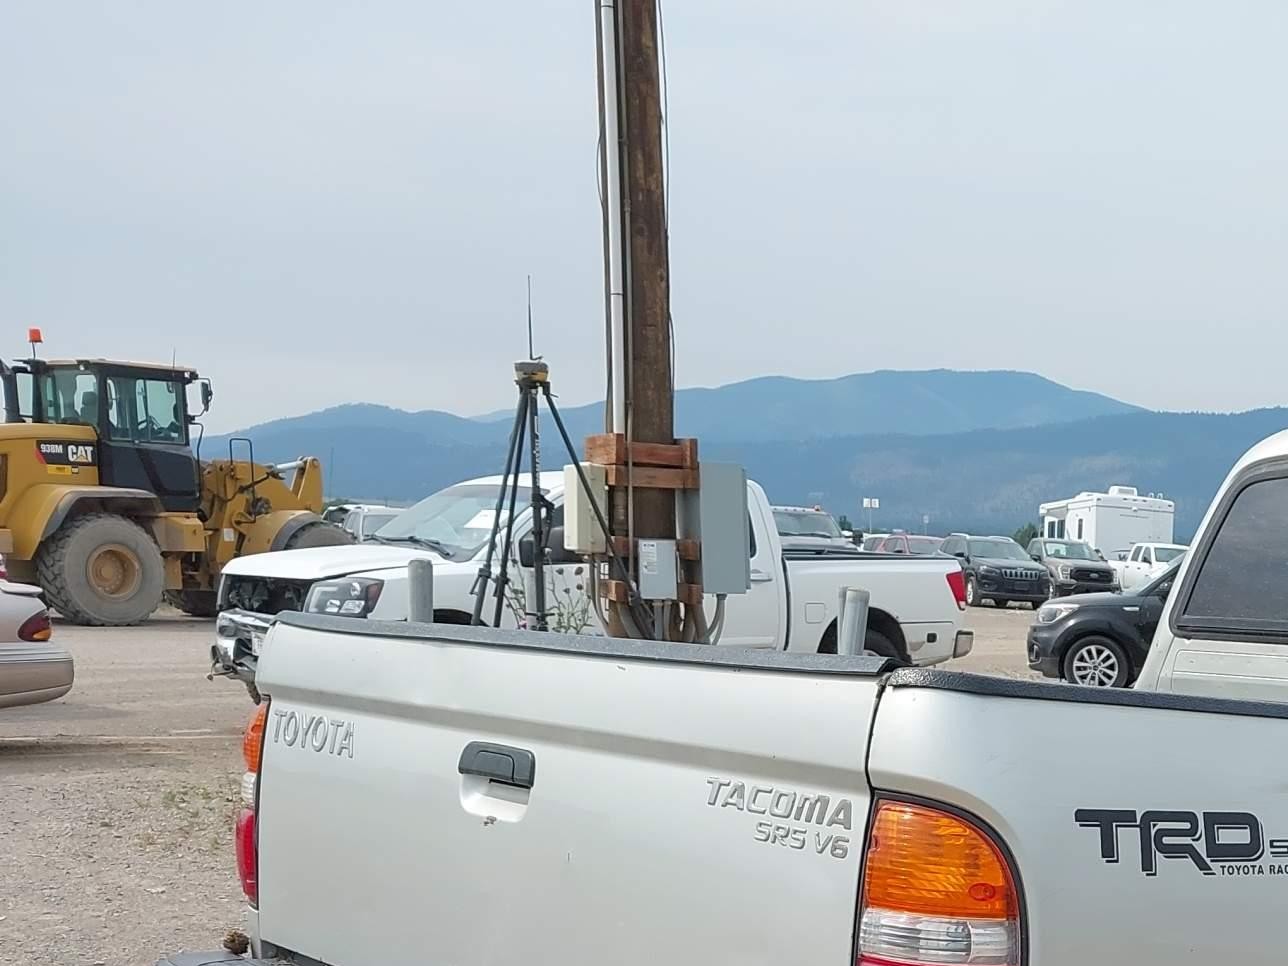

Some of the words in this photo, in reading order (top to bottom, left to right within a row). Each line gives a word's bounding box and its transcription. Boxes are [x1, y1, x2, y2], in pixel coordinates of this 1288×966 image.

[67, 445, 93, 463] CAT
[273, 709, 355, 759] TOYOTA
[706, 776, 853, 831] TACOMA
[813, 831, 849, 859] V6
[1074, 808, 1264, 877] TRD
[1219, 865, 1265, 876] TOYOTA
